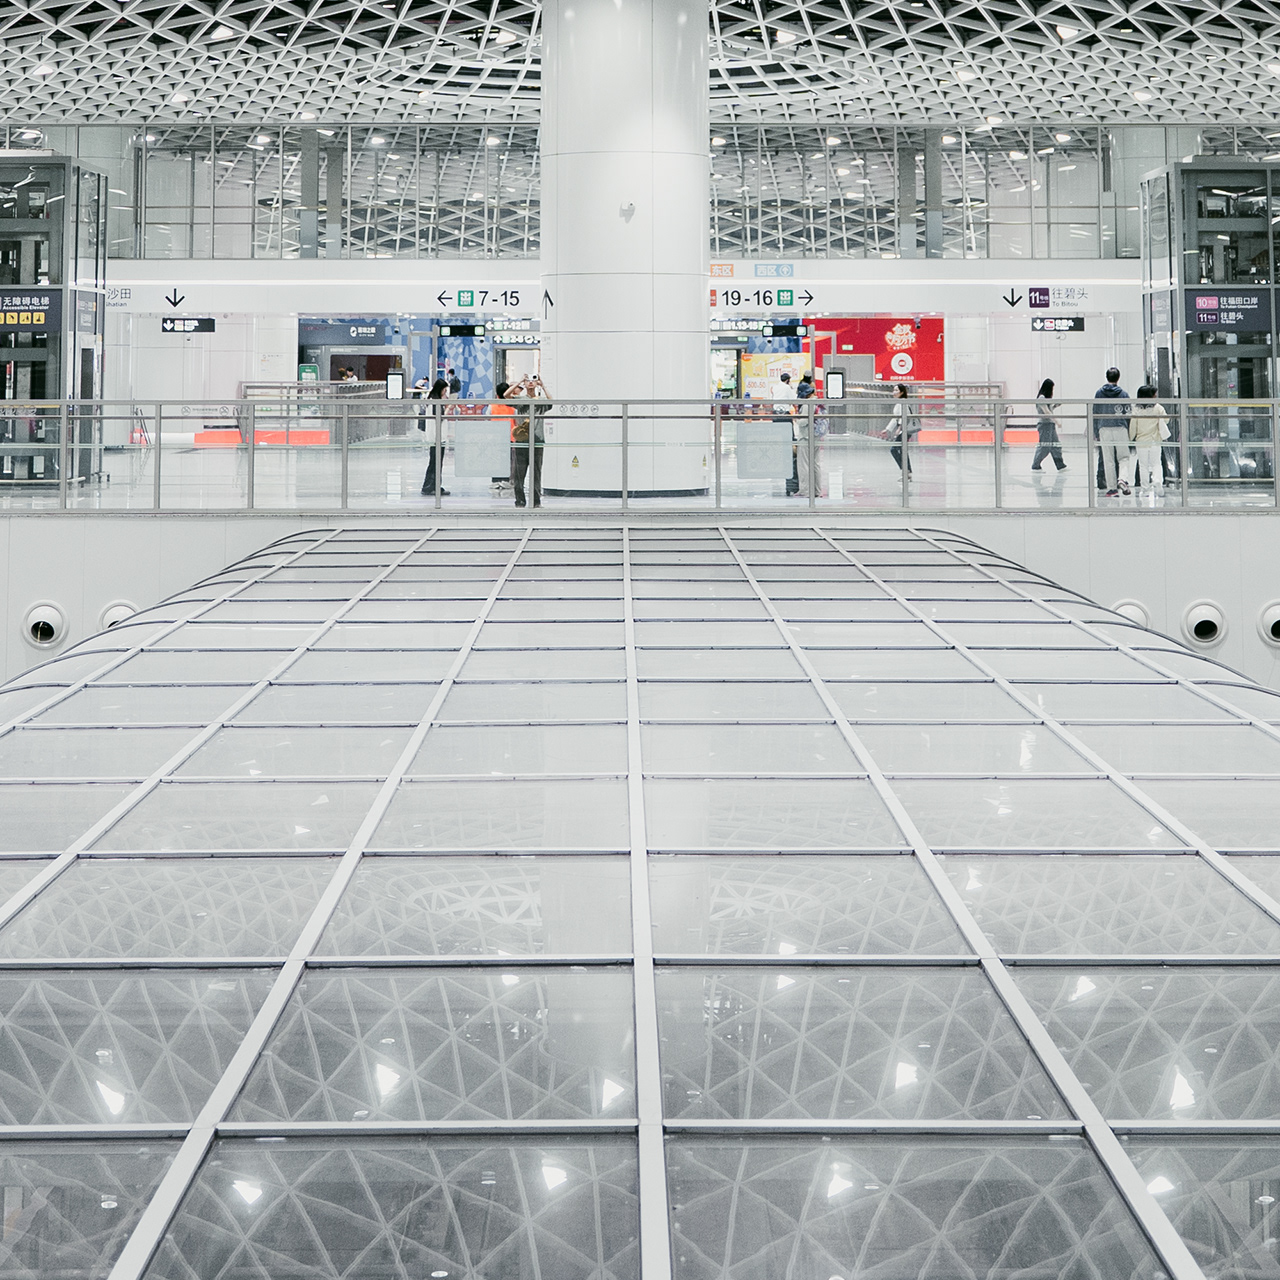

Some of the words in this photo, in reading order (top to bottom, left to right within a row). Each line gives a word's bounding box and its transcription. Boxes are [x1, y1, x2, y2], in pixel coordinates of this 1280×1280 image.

[711, 265, 732, 276] 东区
[107, 288, 131, 300] 沙田
[1029, 291, 1040, 304] 11
[3, 296, 50, 306] 无障碍电梯
[1197, 298, 1208, 307] 10
[1199, 314, 1207, 322] 11
